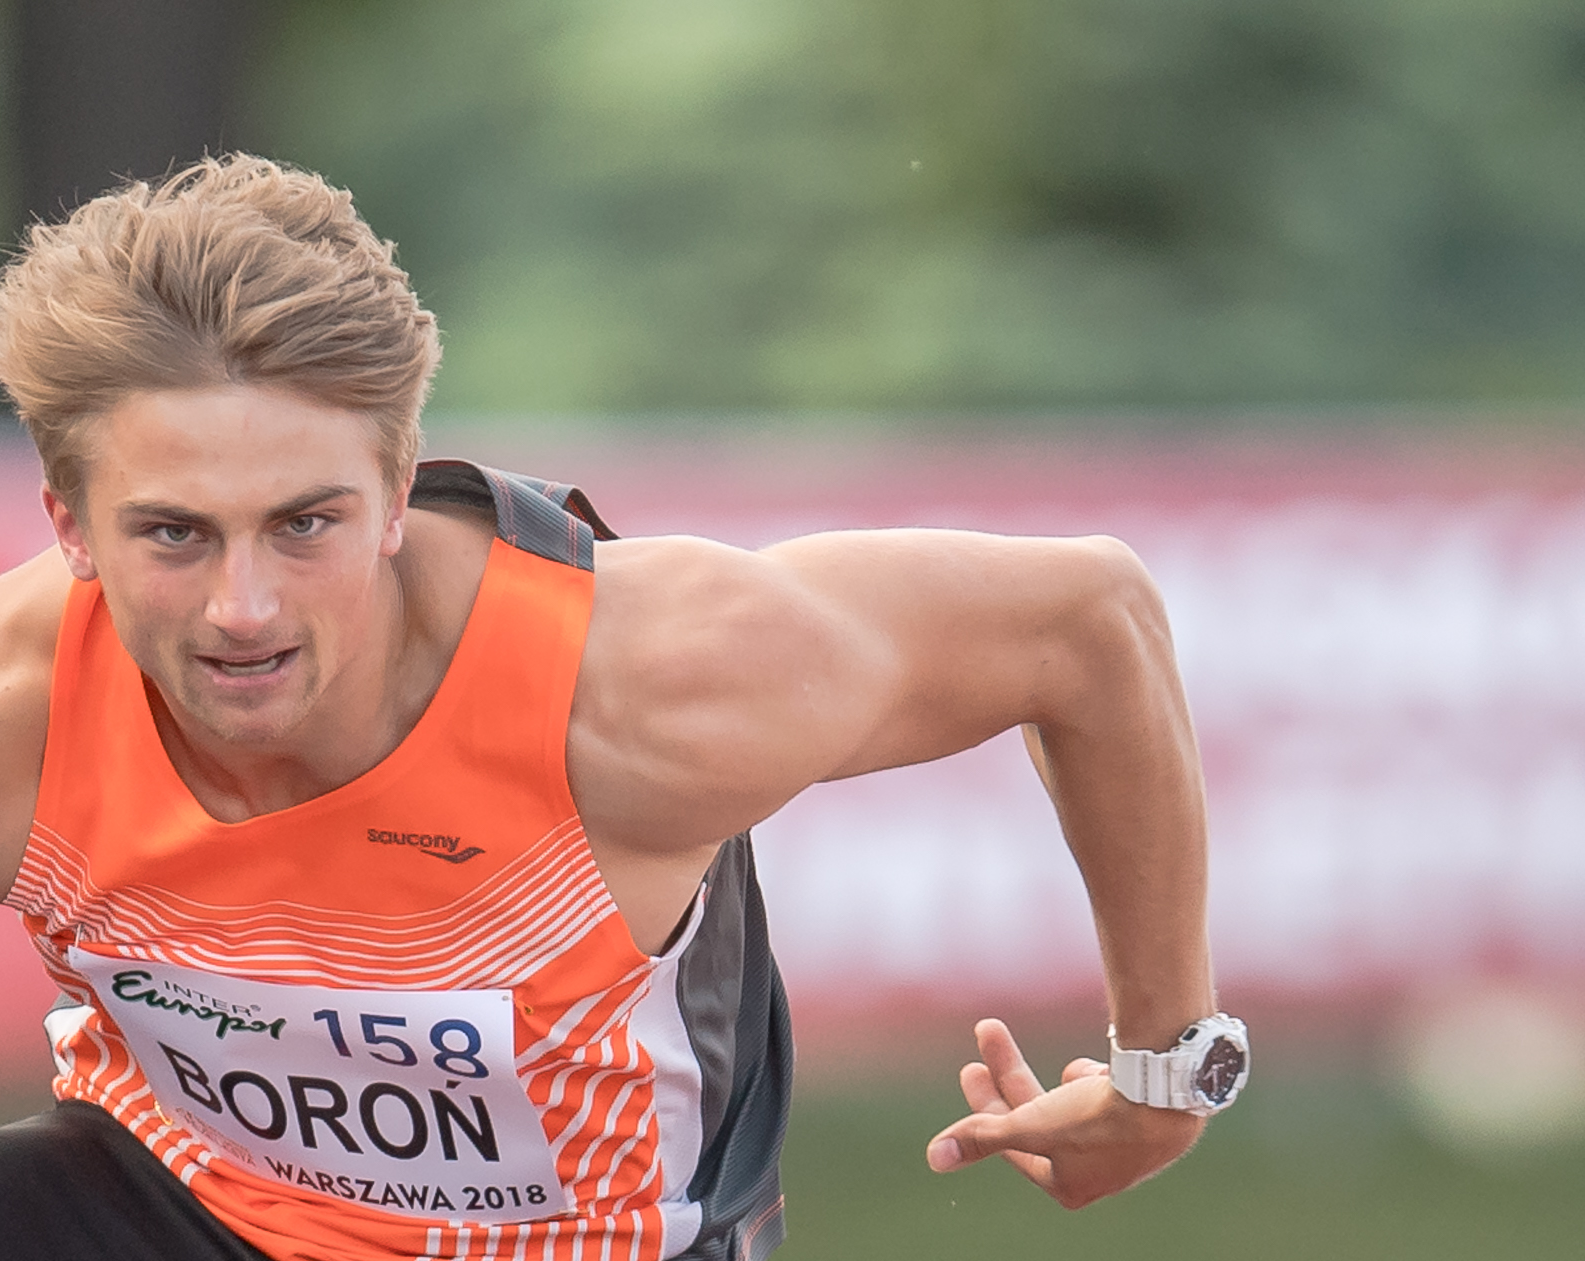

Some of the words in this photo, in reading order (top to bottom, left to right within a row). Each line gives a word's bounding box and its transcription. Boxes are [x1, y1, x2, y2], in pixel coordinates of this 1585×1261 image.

[367, 829, 460, 852] saucony
[164, 980, 252, 1017] INTER
[314, 1008, 490, 1079] 158
[157, 1040, 501, 1162] BOROŃ
[264, 1155, 456, 1211] WARSZAWA
[462, 1184, 548, 1211] 2018
